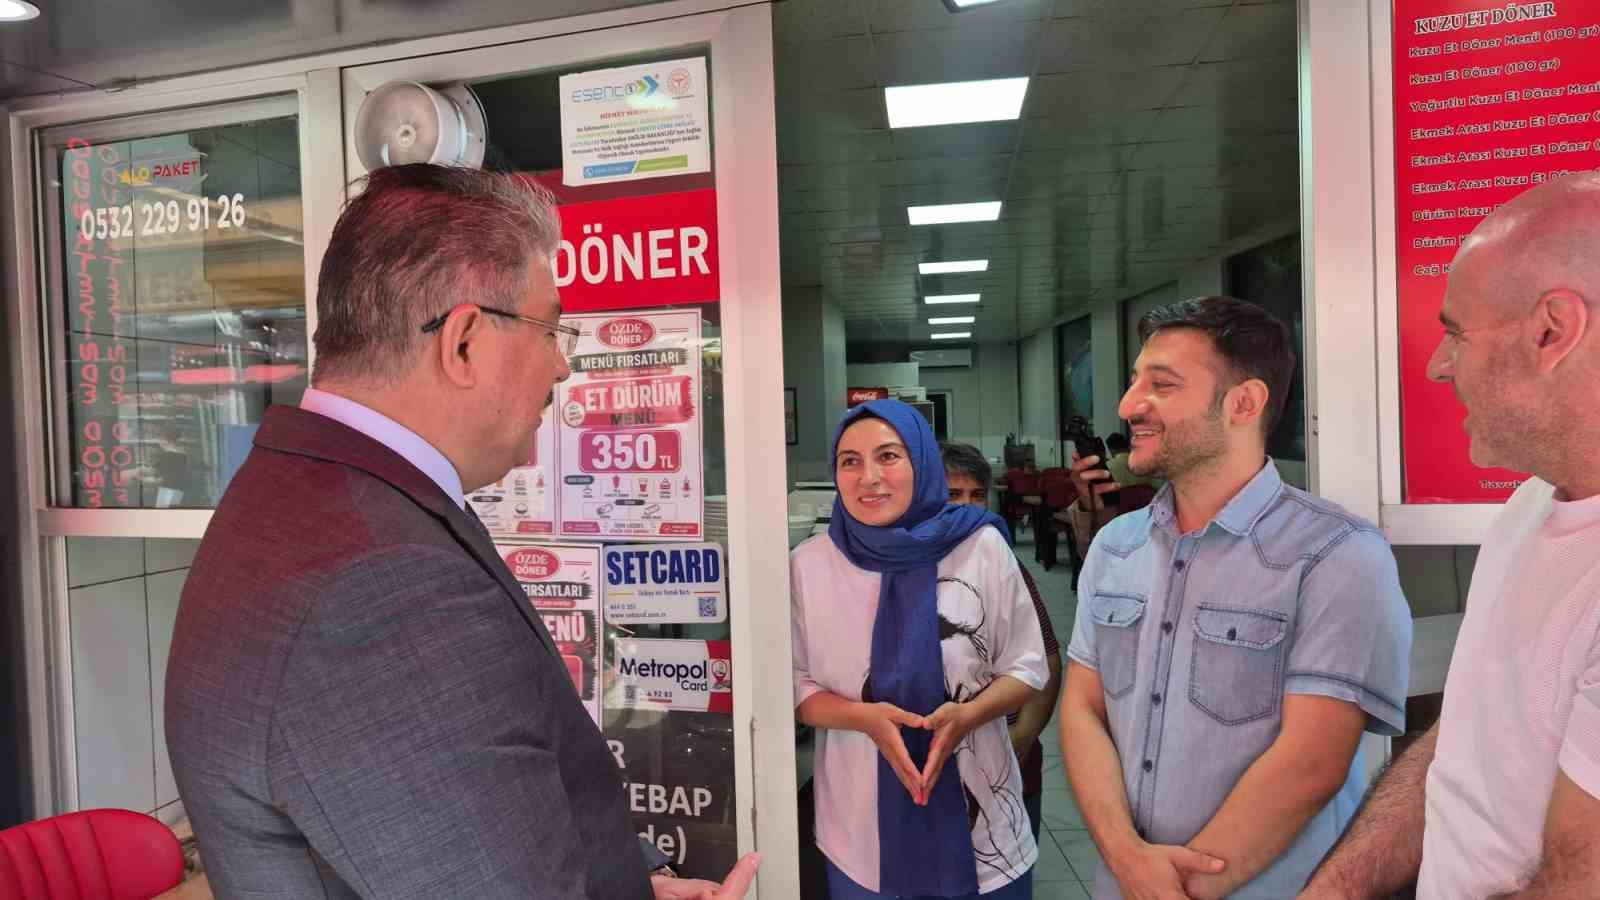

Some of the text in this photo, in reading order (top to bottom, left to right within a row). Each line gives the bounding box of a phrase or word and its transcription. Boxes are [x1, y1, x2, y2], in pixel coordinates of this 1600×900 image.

[1415, 2, 1556, 34] KUZU ET DÖNER
[1409, 46, 1440, 57] Kuzu
[1444, 43, 1457, 54] Et
[1462, 39, 1500, 51] Döner
[1505, 31, 1540, 45] Menü
[1544, 27, 1575, 41] (100
[1409, 58, 1560, 85] Kuzu Et Döner (100 gr)
[1409, 96, 1465, 112] Yoğurtlu
[1469, 93, 1500, 105] Kuzu
[1505, 91, 1520, 102] Et
[1524, 87, 1564, 100] Döner
[1411, 128, 1453, 140] Ekmek
[1493, 119, 1526, 131] Kuzu
[1530, 116, 1544, 127] Et
[1548, 112, 1590, 125] Döner
[1411, 155, 1454, 167] Ekmek
[1494, 147, 1527, 159] Kuzu
[1530, 144, 1545, 155] Et
[1548, 141, 1590, 153] Döner
[153, 160, 199, 177] PAKET
[1412, 182, 1454, 194] Ekmek
[1494, 175, 1527, 187] Kuzu
[1531, 172, 1545, 183] Et
[81, 193, 245, 240] 0532 229 91 26
[1459, 205, 1490, 216] Kuzu
[550, 223, 711, 288] DÖNER
[609, 320, 643, 333] ÖZDE
[610, 333, 641, 345] DÖNER
[581, 350, 680, 369] MENÜ FIRSATLARI
[585, 379, 682, 411] ET DÜRÜM
[611, 410, 656, 425] MENÜ
[592, 433, 674, 469] 350 TL
[515, 551, 549, 565] ÖZDE
[515, 563, 548, 575] DÖNER
[607, 549, 720, 585] SETCARD
[540, 611, 585, 642] ENÜ
[620, 657, 707, 682] Metropol
[681, 680, 708, 691] Card
[623, 782, 713, 816] EBAP
